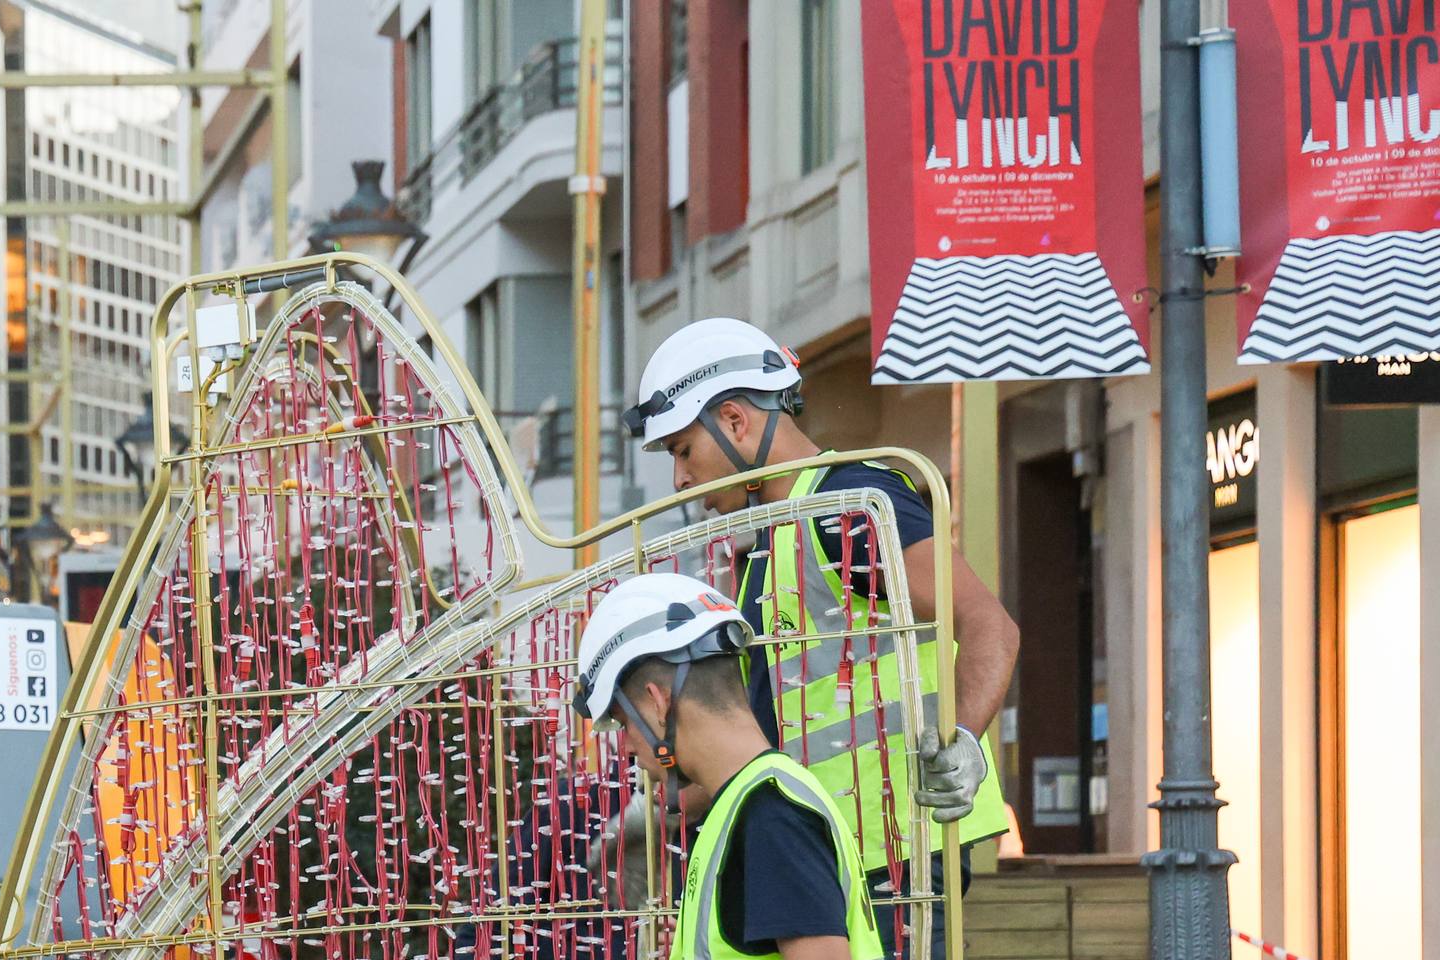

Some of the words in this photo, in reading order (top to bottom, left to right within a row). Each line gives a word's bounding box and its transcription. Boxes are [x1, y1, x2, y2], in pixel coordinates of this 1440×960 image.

[1299, 36, 1440, 154] LYNC
[923, 59, 1082, 170] LYNCH
[1311, 157, 1323, 168] 10
[1326, 157, 1339, 167] de
[1341, 151, 1381, 165] octubre
[1392, 148, 1405, 158] 09
[1408, 148, 1420, 158] de
[934, 173, 945, 185] 10
[948, 173, 959, 183] de
[961, 173, 997, 183] octubre
[1004, 172, 1016, 182] 09
[1018, 172, 1029, 181] de
[1031, 171, 1074, 182] diciembre
[667, 364, 719, 398] ONNIGHT
[1377, 362, 1411, 376] MAN
[588, 631, 624, 680] ONNIGHT
[13, 704, 49, 724] 031
